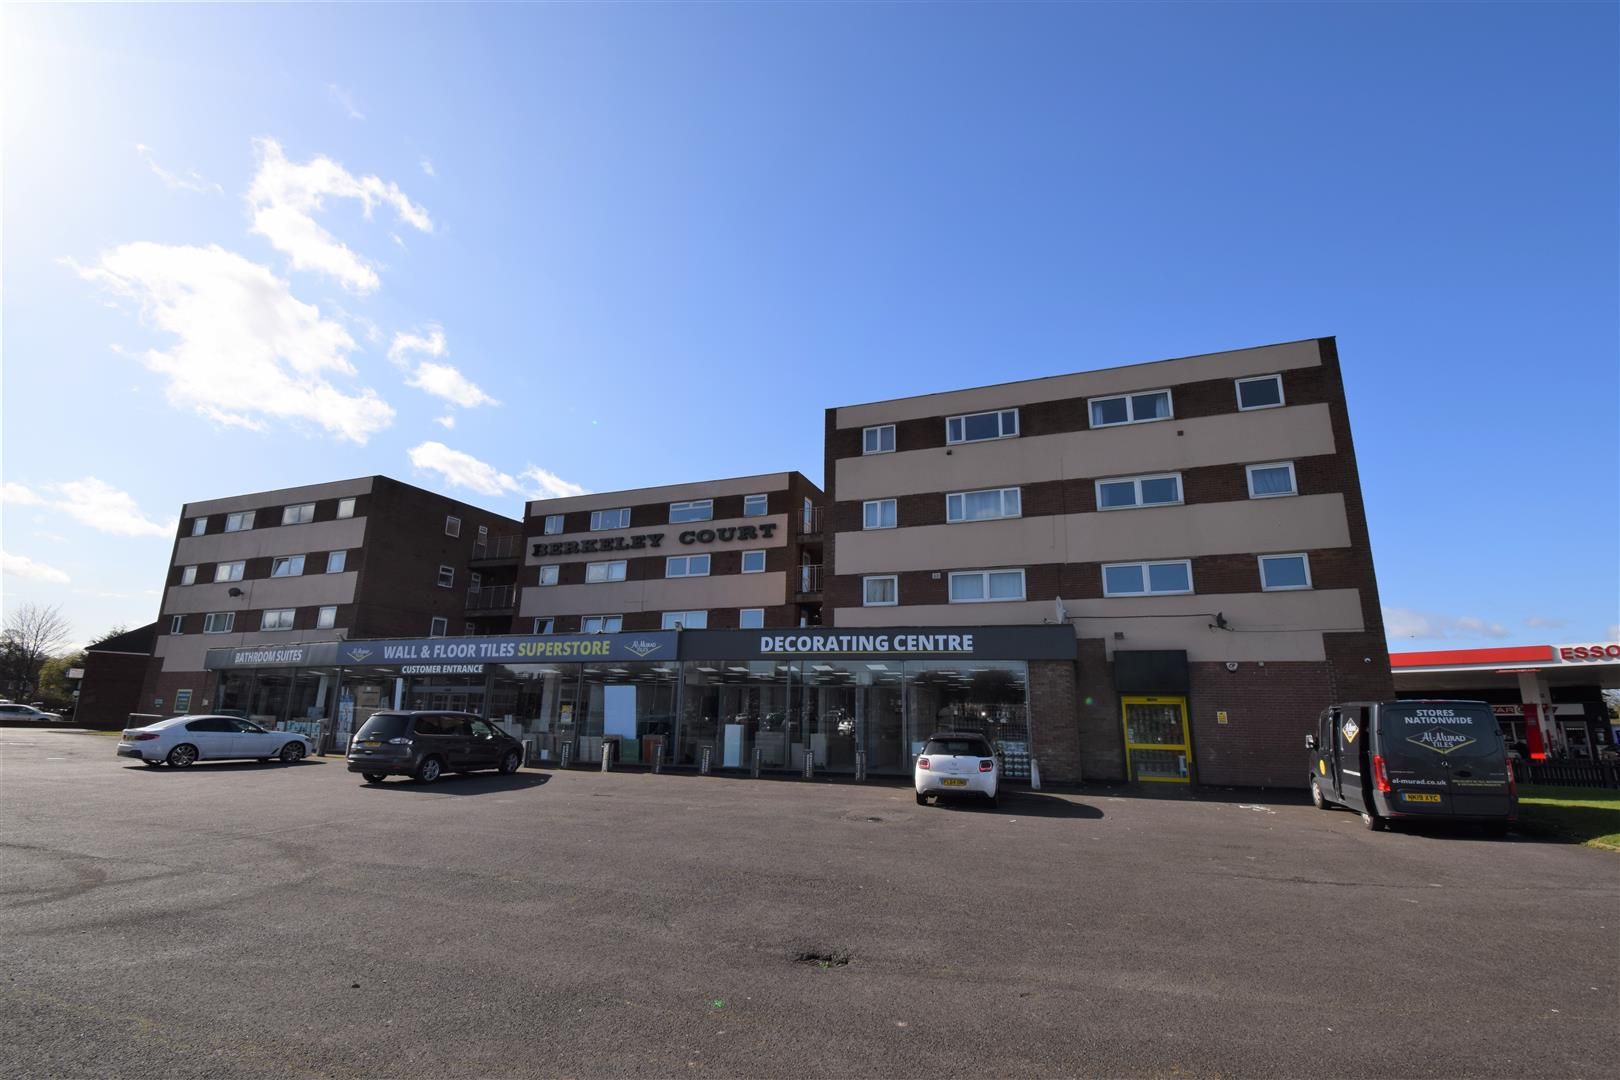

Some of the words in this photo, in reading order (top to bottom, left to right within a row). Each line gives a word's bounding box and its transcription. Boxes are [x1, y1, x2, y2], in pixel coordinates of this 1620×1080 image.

[532, 533, 665, 557] BERKELEY
[679, 523, 777, 545] COURT
[384, 645, 418, 659] WALL
[421, 645, 430, 659] &
[433, 644, 477, 658] FLOOR
[479, 643, 515, 657] TILES
[518, 640, 611, 657] SUPERSTORE
[760, 635, 889, 652] DECORATING
[893, 634, 973, 651] CENTRE
[235, 651, 276, 664] BATHROOM
[276, 649, 303, 663] SUITES
[1560, 644, 1620, 660] ESSO
[402, 665, 442, 674] CUSTOMER
[443, 664, 483, 673] ENTRANCE
[1404, 716, 1473, 725] NATIONWIDE
[1416, 709, 1455, 717] STORES
